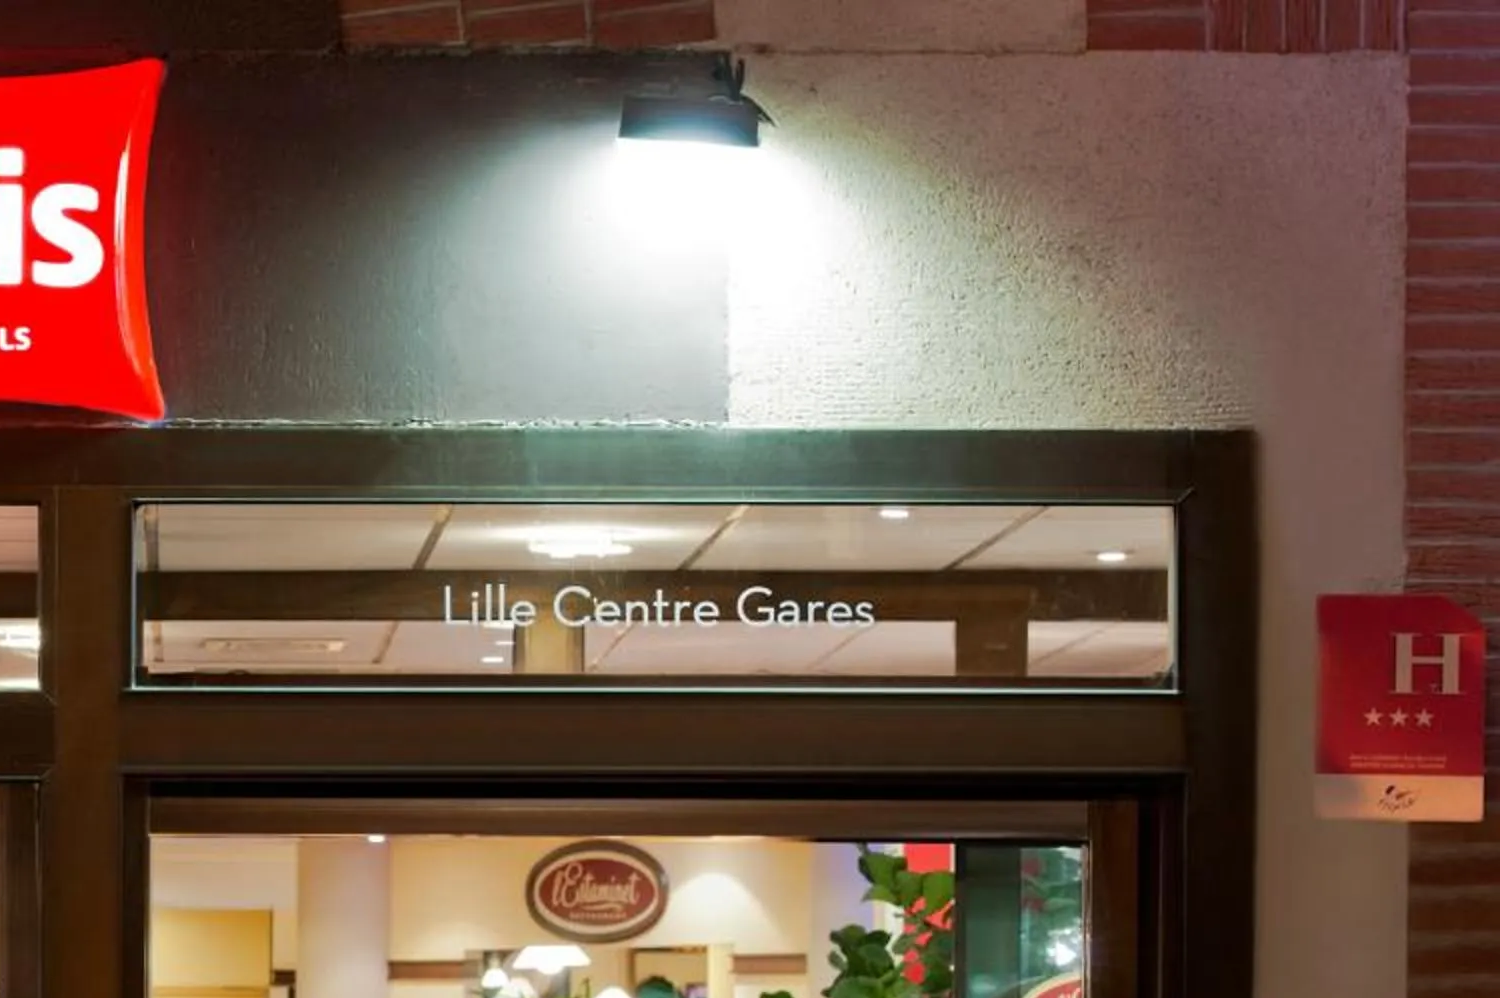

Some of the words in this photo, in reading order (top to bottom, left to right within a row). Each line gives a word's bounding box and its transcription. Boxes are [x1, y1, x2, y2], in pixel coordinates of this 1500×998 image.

[443, 583, 536, 628] Lille
[553, 585, 719, 628] Centre
[736, 586, 875, 628] Gares
[1389, 633, 1467, 694] H
